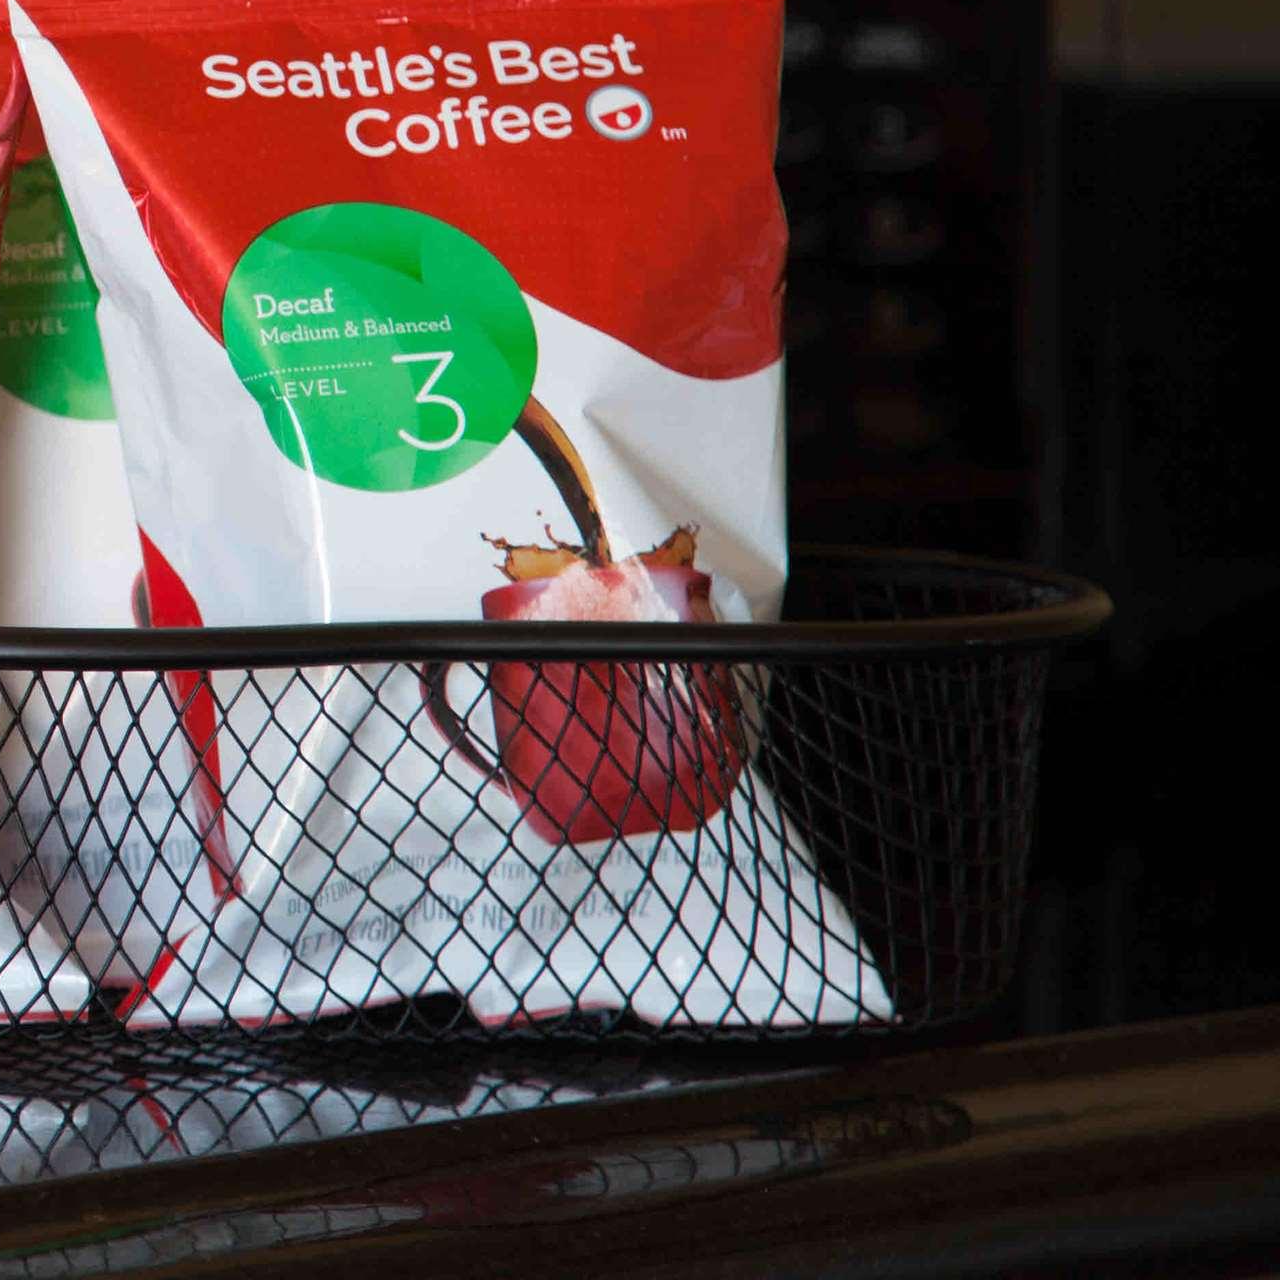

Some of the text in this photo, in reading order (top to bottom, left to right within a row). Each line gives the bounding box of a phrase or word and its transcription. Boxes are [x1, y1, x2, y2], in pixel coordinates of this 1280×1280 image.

[201, 33, 645, 100] Seattle's Best
[345, 95, 573, 159] Coffee
[253, 287, 336, 319] Decaf
[259, 314, 452, 346] Medium & Balanced
[270, 378, 348, 400] LEVEL
[391, 351, 466, 451] 3
